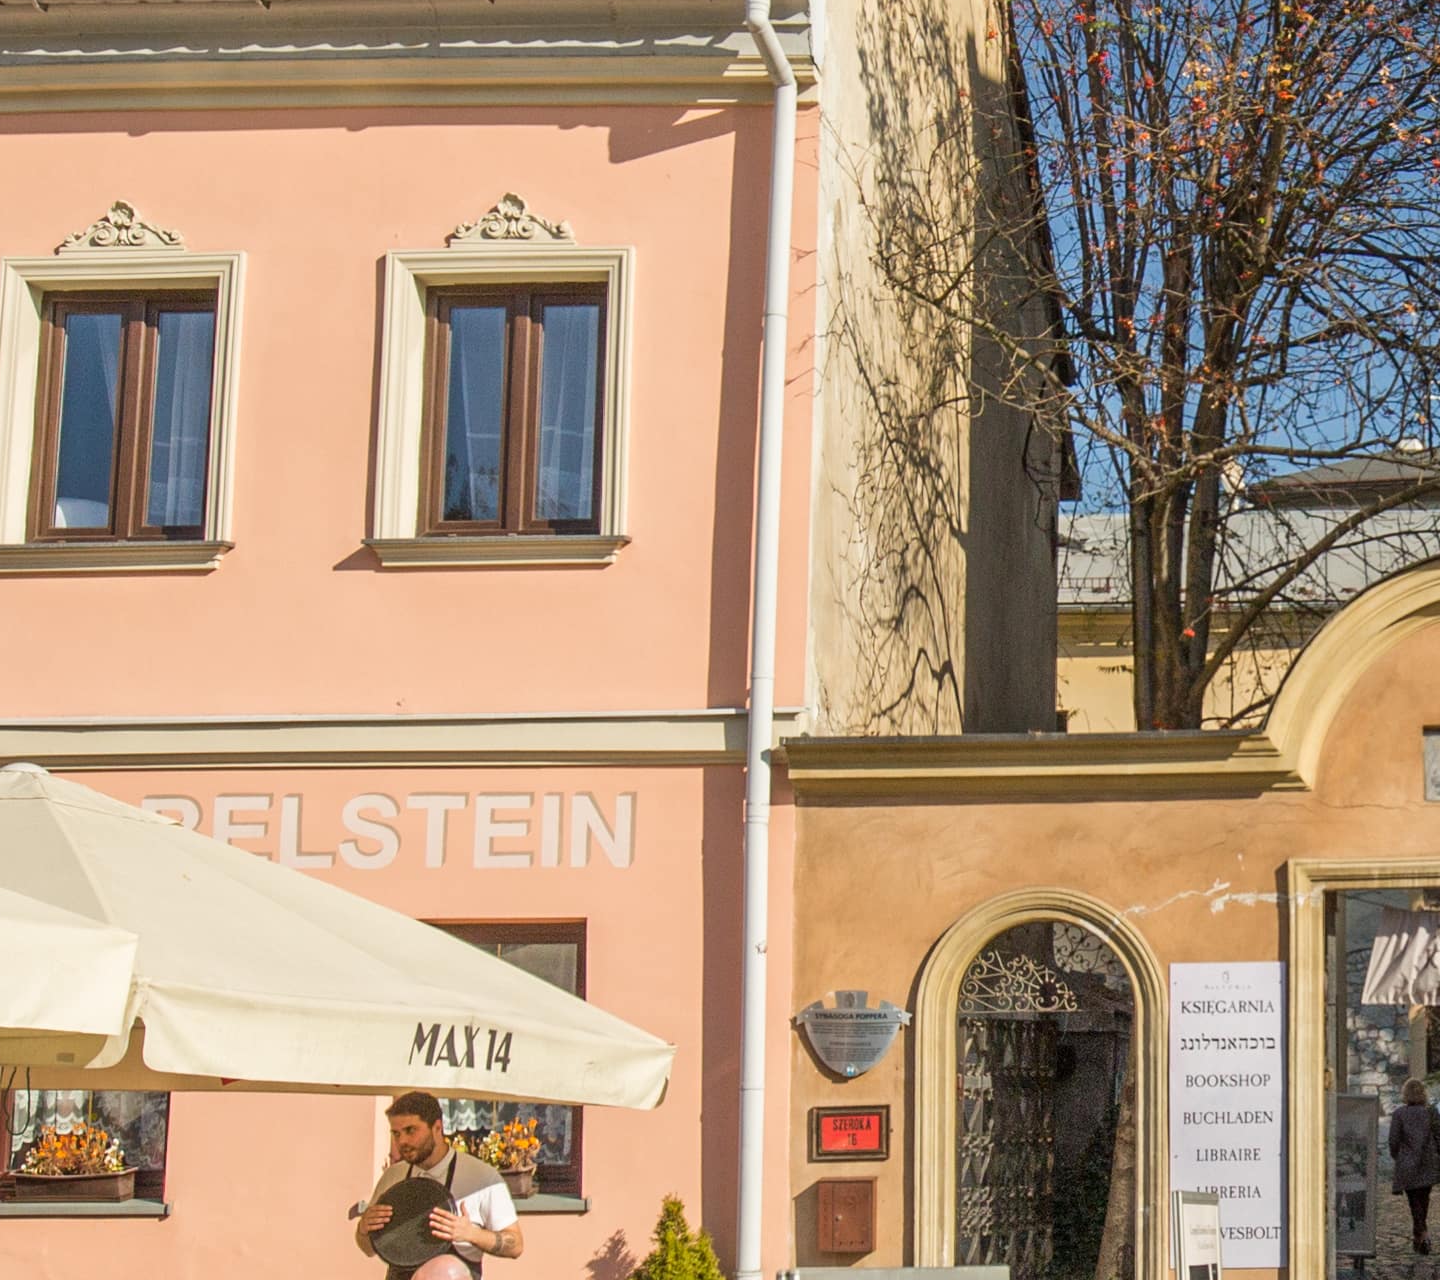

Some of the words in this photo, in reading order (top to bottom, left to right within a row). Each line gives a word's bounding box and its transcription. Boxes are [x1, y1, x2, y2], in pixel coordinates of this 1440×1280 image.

[1180, 999, 1275, 1016] KSIĘGARNIA
[409, 1021, 480, 1069] MAX
[486, 1028, 513, 1073] 14
[1180, 1032, 1276, 1051] בוכהאנדלונג
[1185, 1073, 1271, 1088] BOOKSHOP
[832, 1118, 872, 1132] SZEROKA
[1183, 1111, 1274, 1125] BUCHLADEN
[847, 1133, 858, 1146] 16
[1196, 1148, 1262, 1161] LIBRAIRE
[1220, 1226, 1282, 1240] VESBOLT
